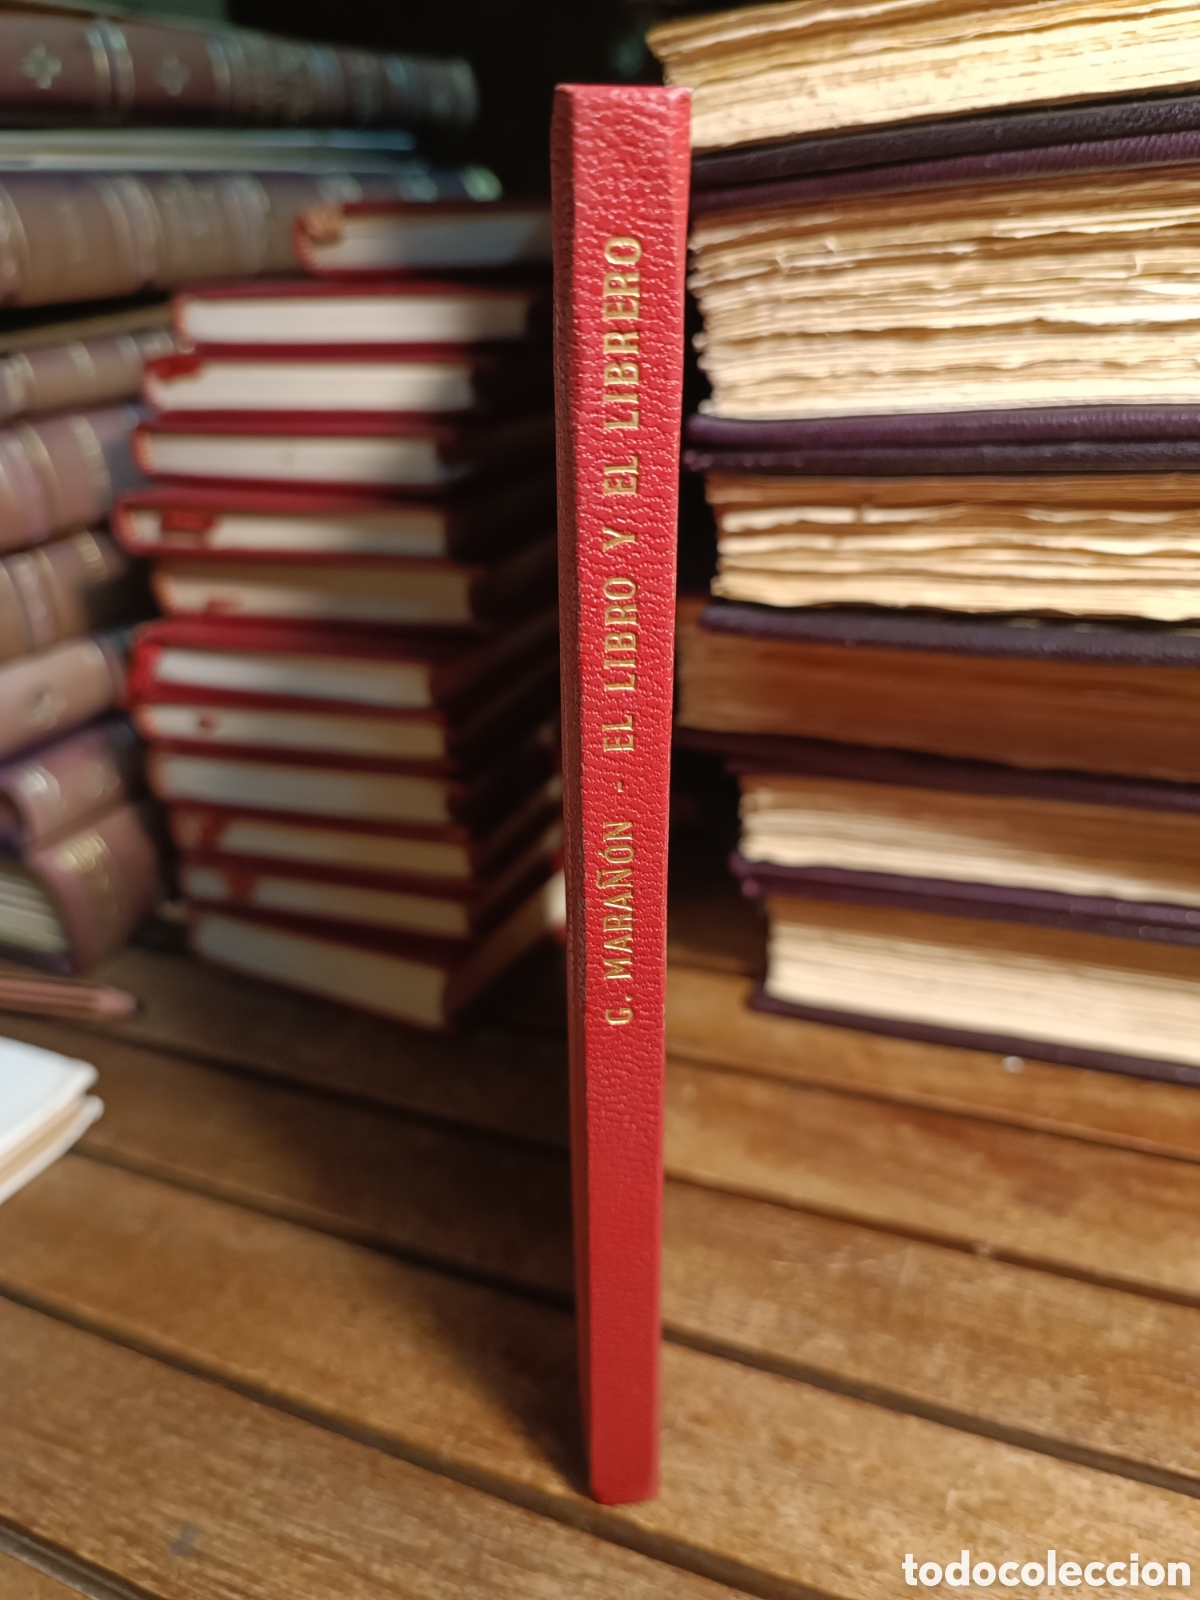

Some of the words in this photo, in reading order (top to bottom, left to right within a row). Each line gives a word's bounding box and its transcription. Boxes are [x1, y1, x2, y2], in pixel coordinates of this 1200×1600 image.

[603, 235, 643, 430] LIBRERO
[603, 454, 640, 498] EL
[602, 524, 639, 554] Y
[603, 576, 639, 692] LIBRO
[602, 713, 636, 753] EL
[596, 820, 636, 981] MARAÑÓN
[603, 993, 635, 1027] G.
